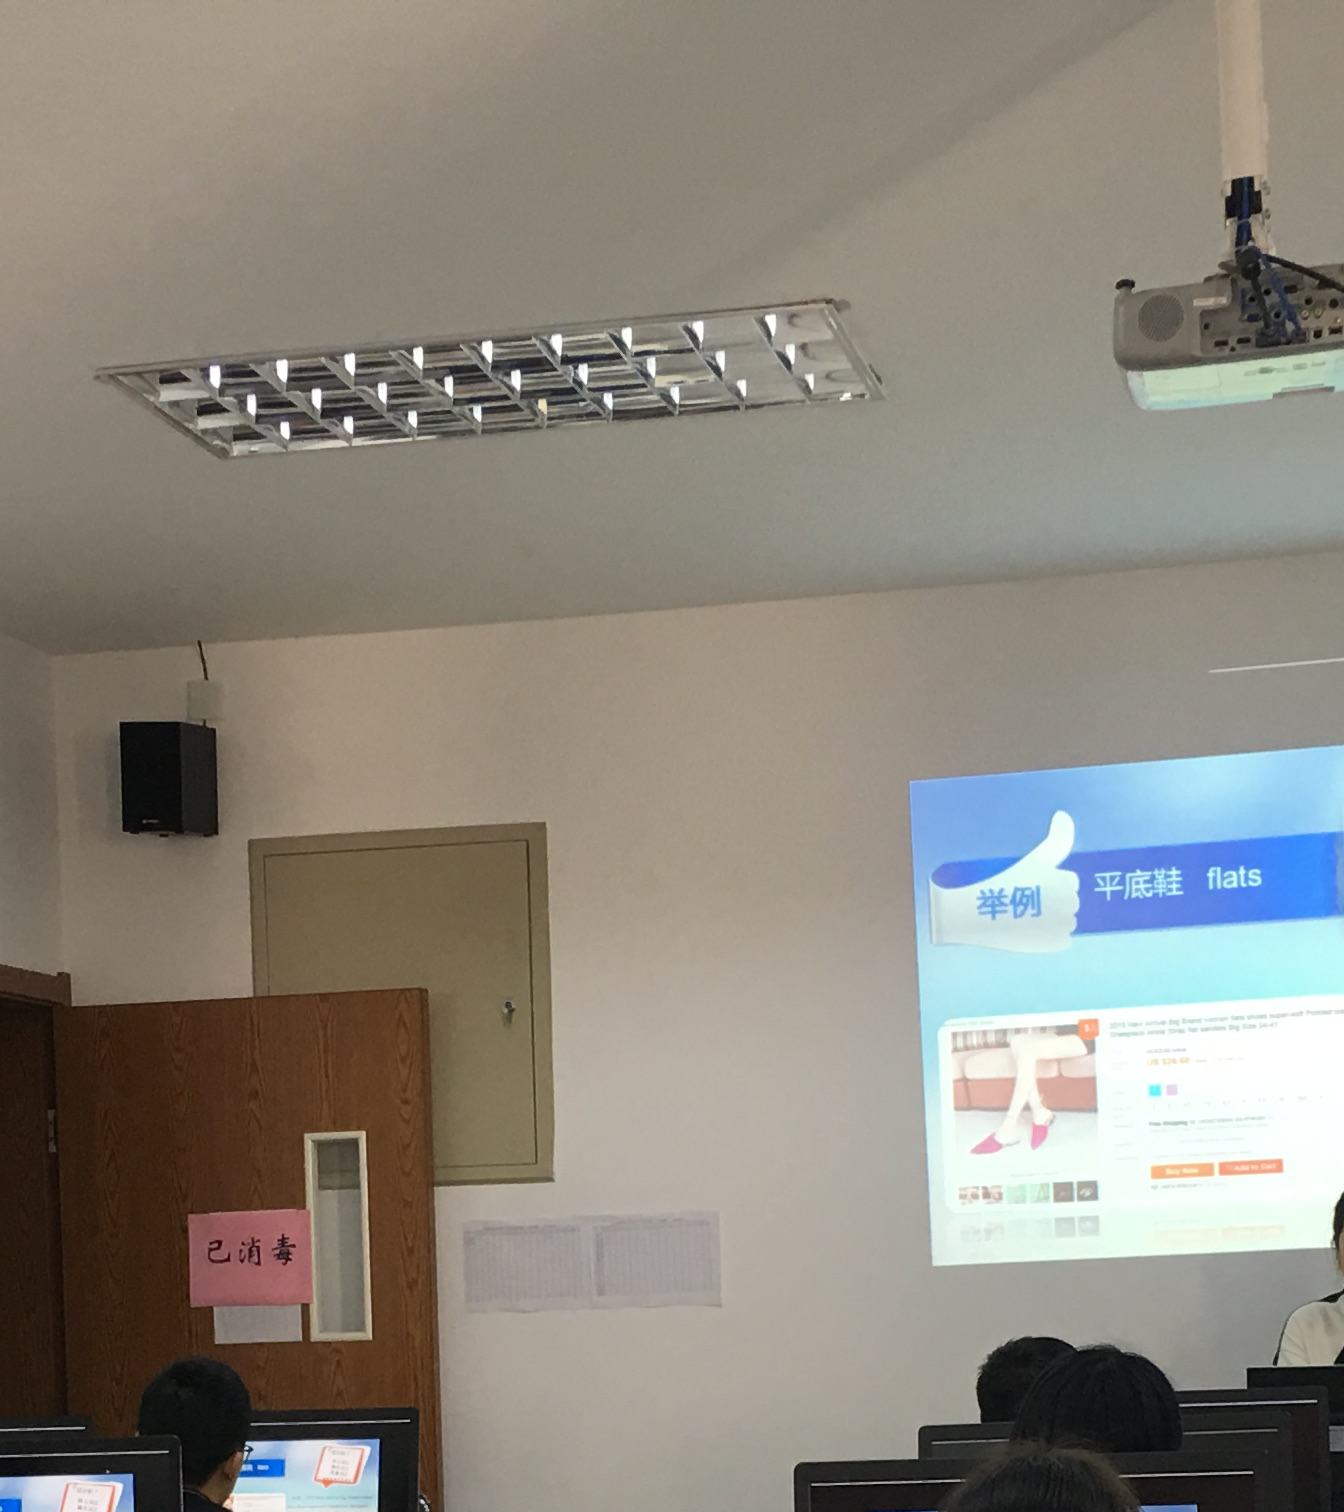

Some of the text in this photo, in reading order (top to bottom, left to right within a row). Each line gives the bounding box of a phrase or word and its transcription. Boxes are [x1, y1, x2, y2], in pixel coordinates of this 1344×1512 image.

[1094, 866, 1261, 901] 平底鞋 flats
[976, 885, 1042, 920] 举例
